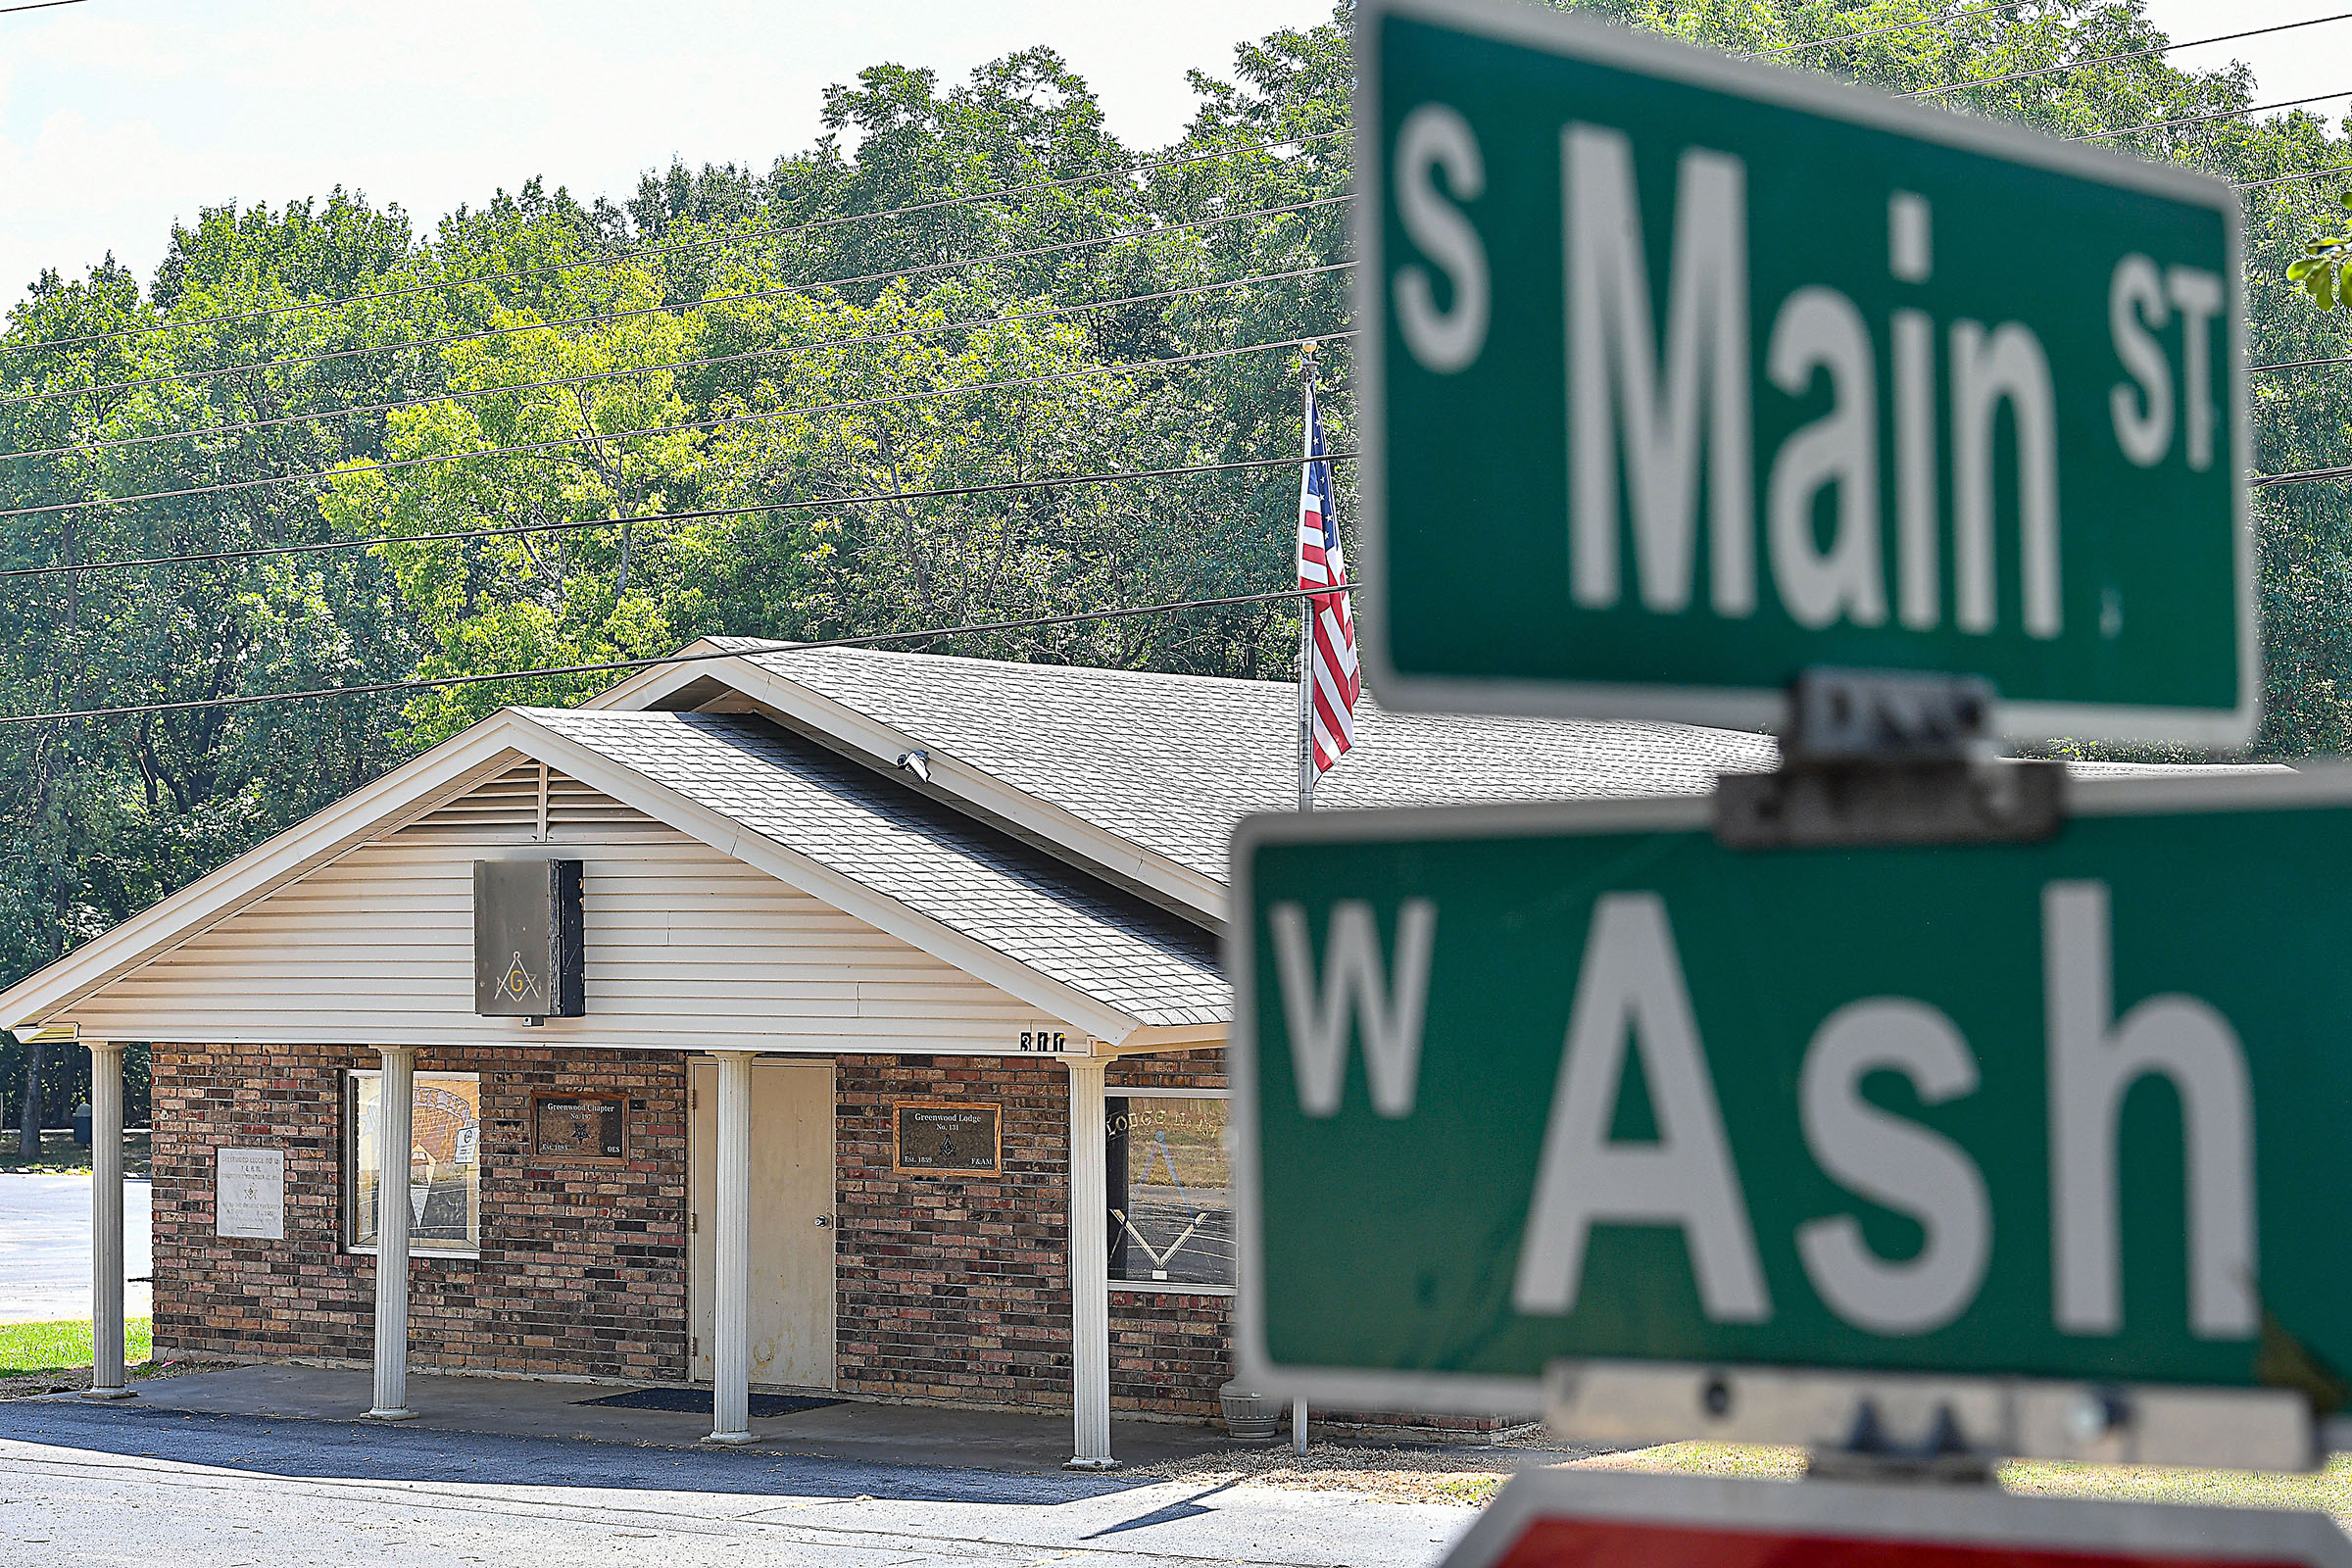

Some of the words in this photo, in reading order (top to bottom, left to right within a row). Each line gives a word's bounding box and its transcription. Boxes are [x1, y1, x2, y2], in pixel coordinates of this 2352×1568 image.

[1393, 102, 1492, 374] S
[1559, 121, 2064, 640] Main
[2108, 252, 2224, 473] ST
[510, 969, 523, 993] G
[1021, 1035, 1062, 1052] 311
[547, 1102, 586, 1111] Greenwood
[587, 1103, 615, 1113] Chapter
[914, 1112, 957, 1122] Greenwood
[958, 1113, 982, 1124] Lodge
[1270, 896, 1438, 1120] W
[1512, 879, 2261, 1342] Ash
[1105, 1109, 1166, 1136] LODGE
